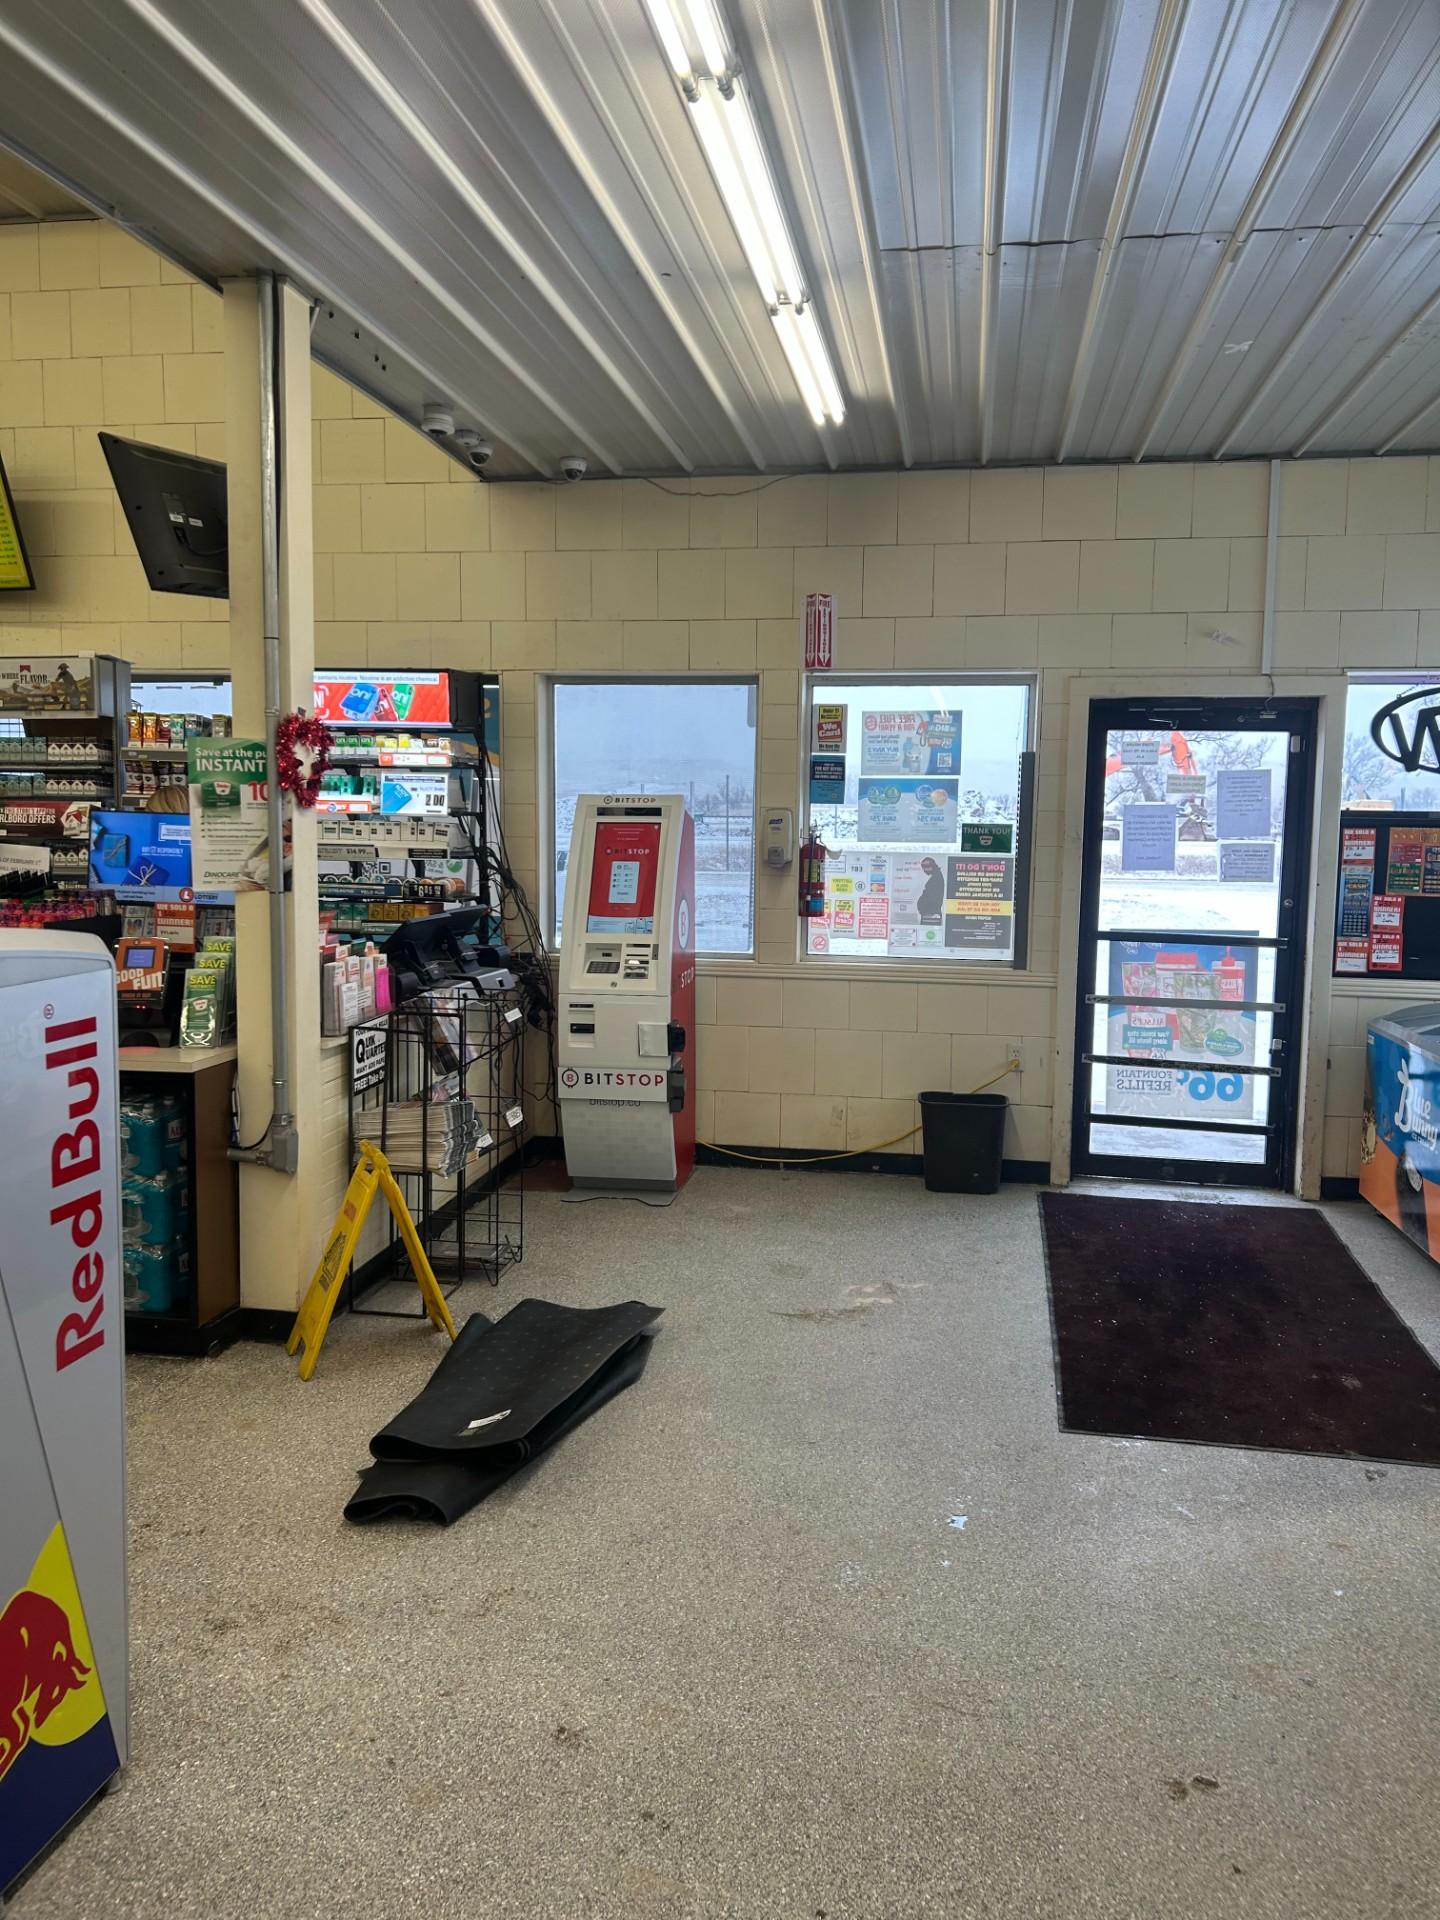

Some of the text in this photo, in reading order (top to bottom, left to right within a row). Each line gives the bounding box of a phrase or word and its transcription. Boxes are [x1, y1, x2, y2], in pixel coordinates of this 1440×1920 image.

[819, 728, 840, 738] Card
[195, 748, 221, 757] Save
[222, 749, 233, 758] at
[236, 749, 254, 758] the
[196, 759, 266, 772] INSTANT
[29, 815, 56, 824] OFFERS
[964, 826, 1011, 834] THANK YOU!
[207, 943, 232, 951] SAVE
[199, 960, 225, 968] SAVE
[190, 976, 216, 985] SAVE
[681, 968, 694, 988] STOP
[584, 1073, 664, 1086] BITSTOP
[45, 1016, 101, 1188] Bull
[50, 1189, 105, 1372] Red
